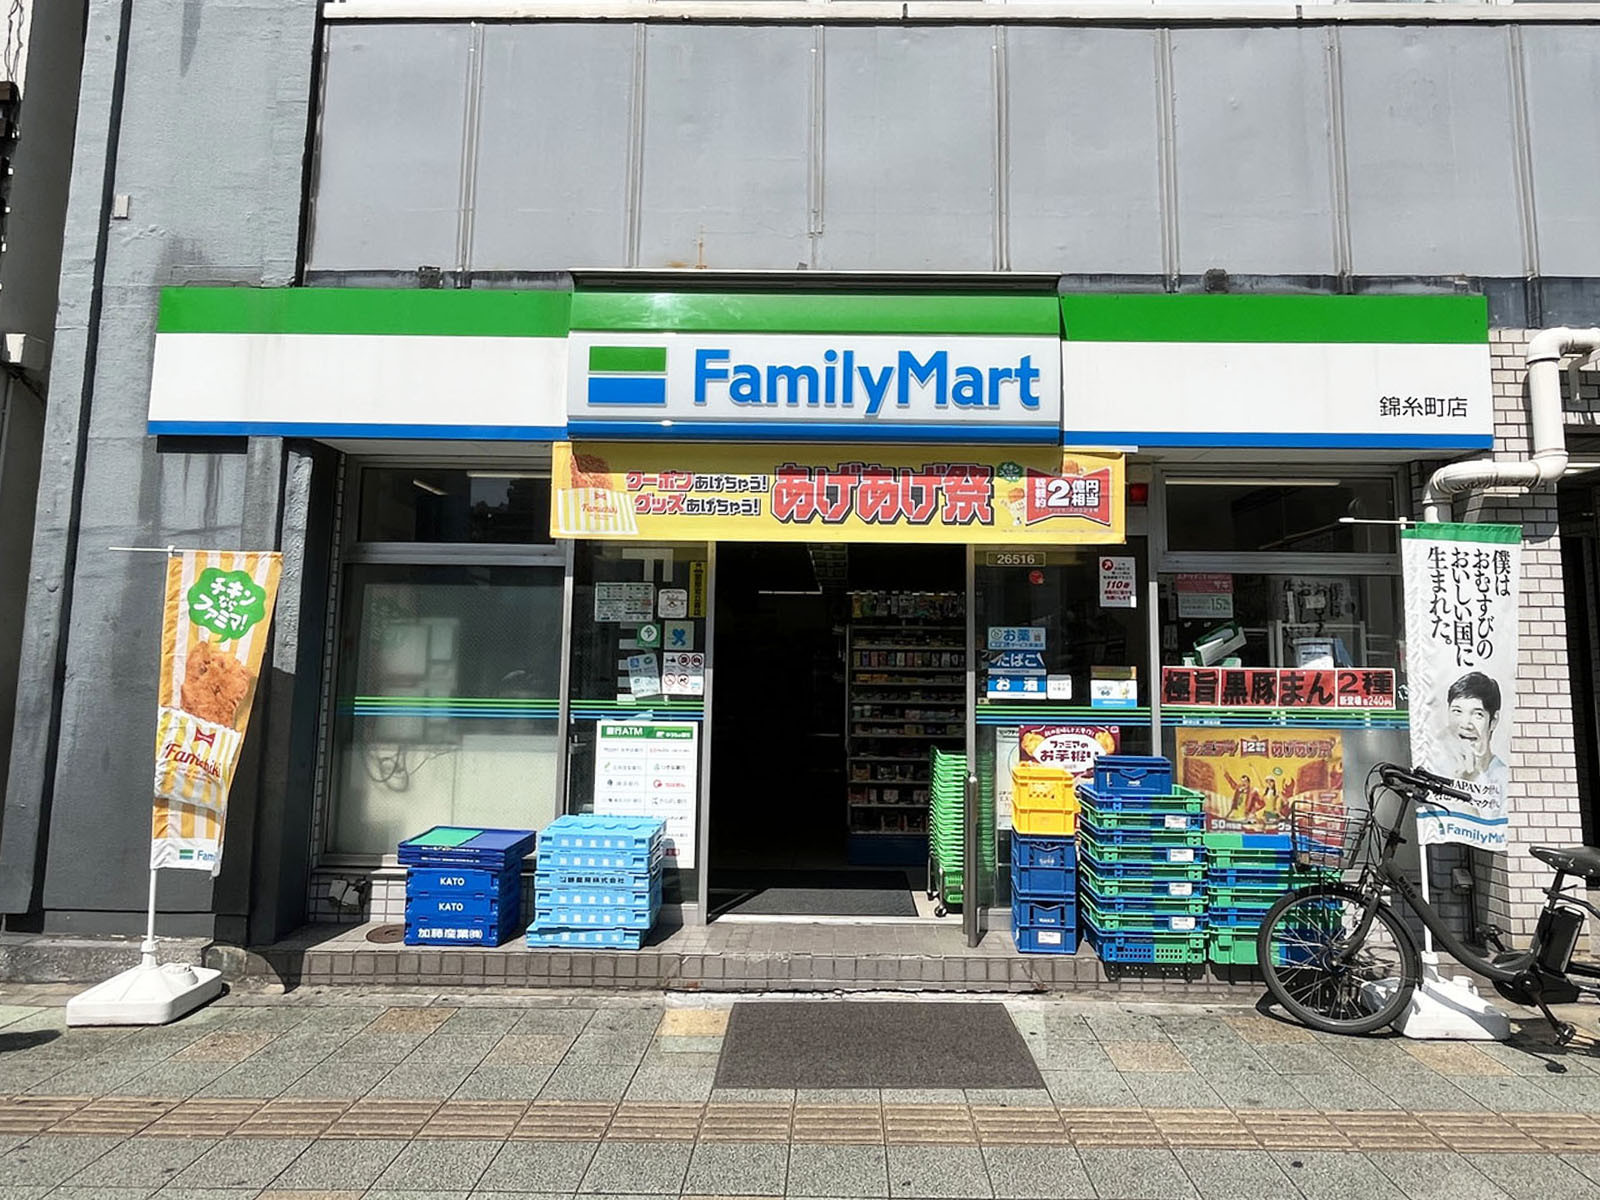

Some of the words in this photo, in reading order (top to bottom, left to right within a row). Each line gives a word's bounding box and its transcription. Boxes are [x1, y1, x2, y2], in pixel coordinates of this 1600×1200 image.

[694, 348, 1041, 420] FamilyMart
[1379, 396, 1468, 417] 錦糸町店
[634, 493, 762, 516] グッズあげちゃう!
[771, 463, 995, 526] あげあげ祭
[997, 554, 1035, 564] 26516
[1492, 549, 1512, 597] 僕は
[1427, 546, 1453, 645] 生まれた。
[1451, 546, 1475, 667] おいしい国に
[1472, 548, 1495, 661] おむすびの
[997, 652, 1038, 667] たばこ
[1165, 669, 1393, 705] 極旨黒豚まん2種
[1050, 740, 1088, 749] ファミマの
[440, 877, 465, 886] KATO
[438, 903, 464, 911] KATO
